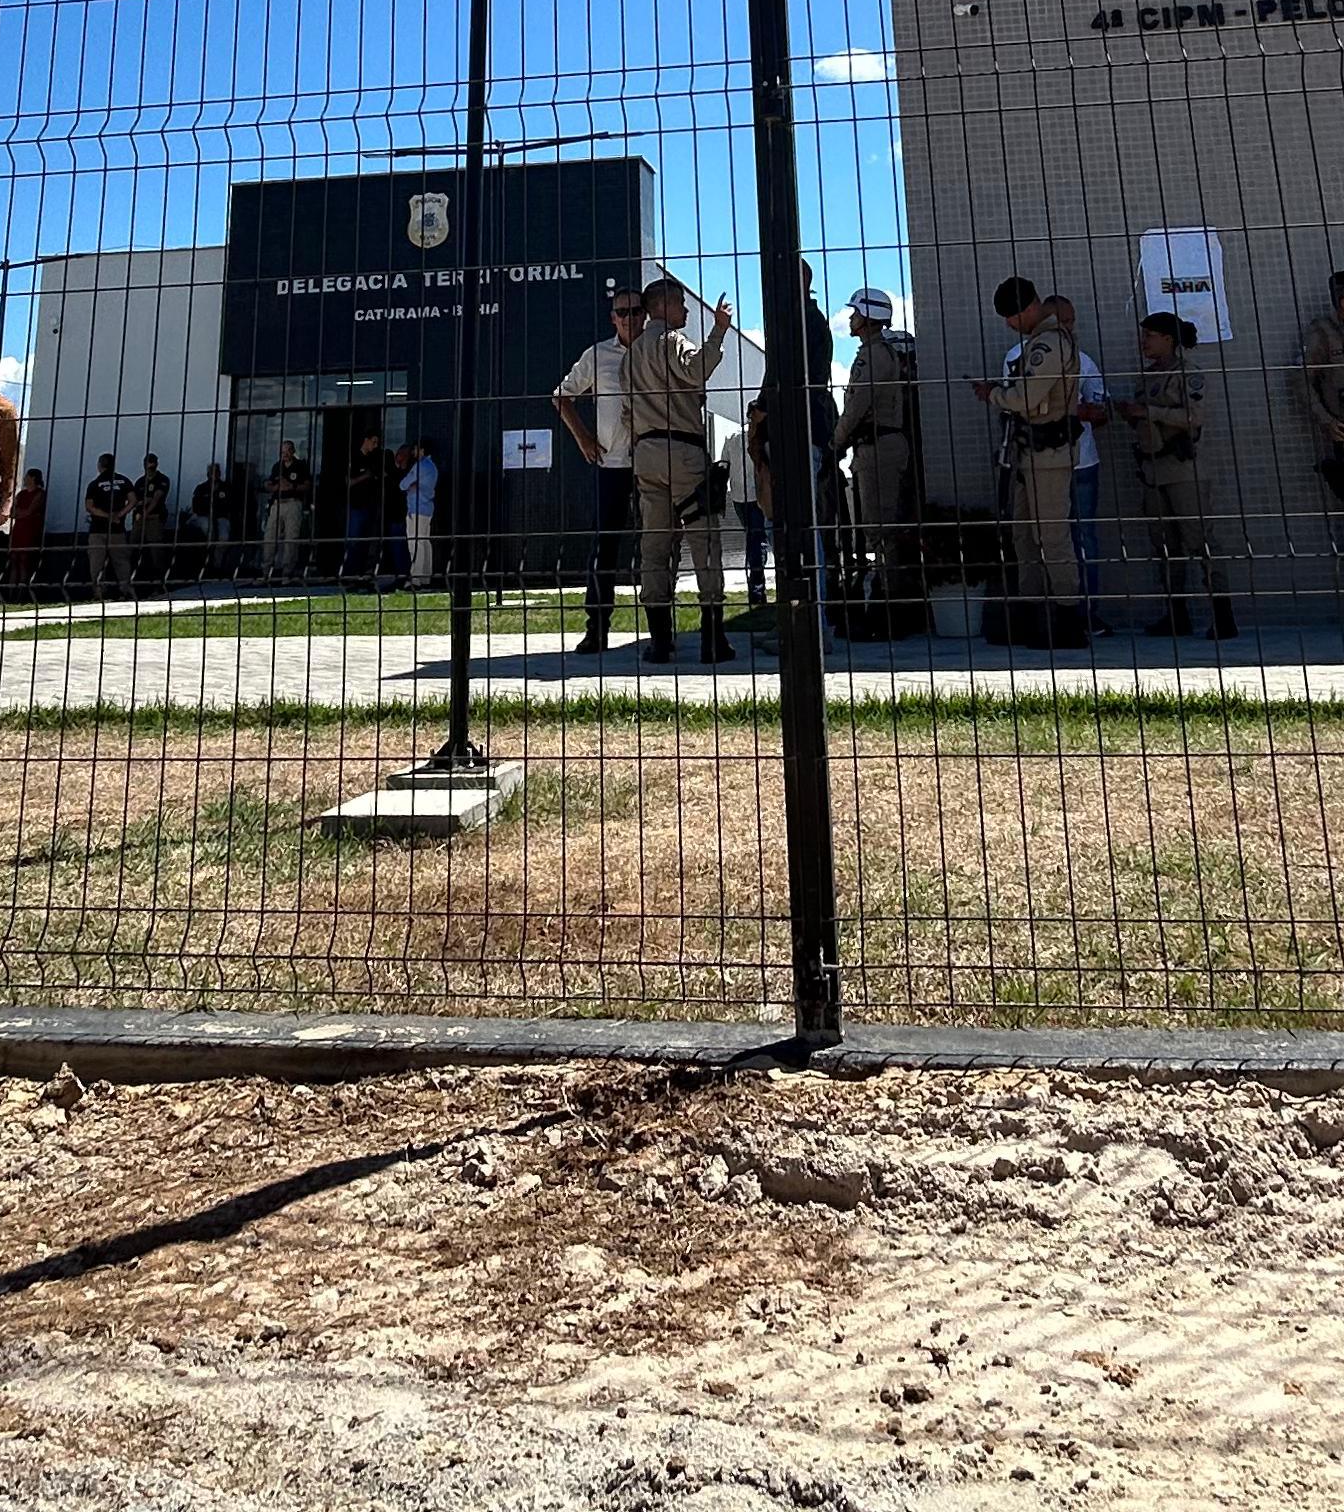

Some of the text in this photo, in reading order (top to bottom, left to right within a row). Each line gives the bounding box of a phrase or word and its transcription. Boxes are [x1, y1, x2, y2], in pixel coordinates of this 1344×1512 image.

[1138, 3, 1225, 31] CIPM
[276, 272, 408, 295] DELEGACIA
[354, 307, 441, 321] CATURAMA
[452, 302, 500, 317] BHIA
